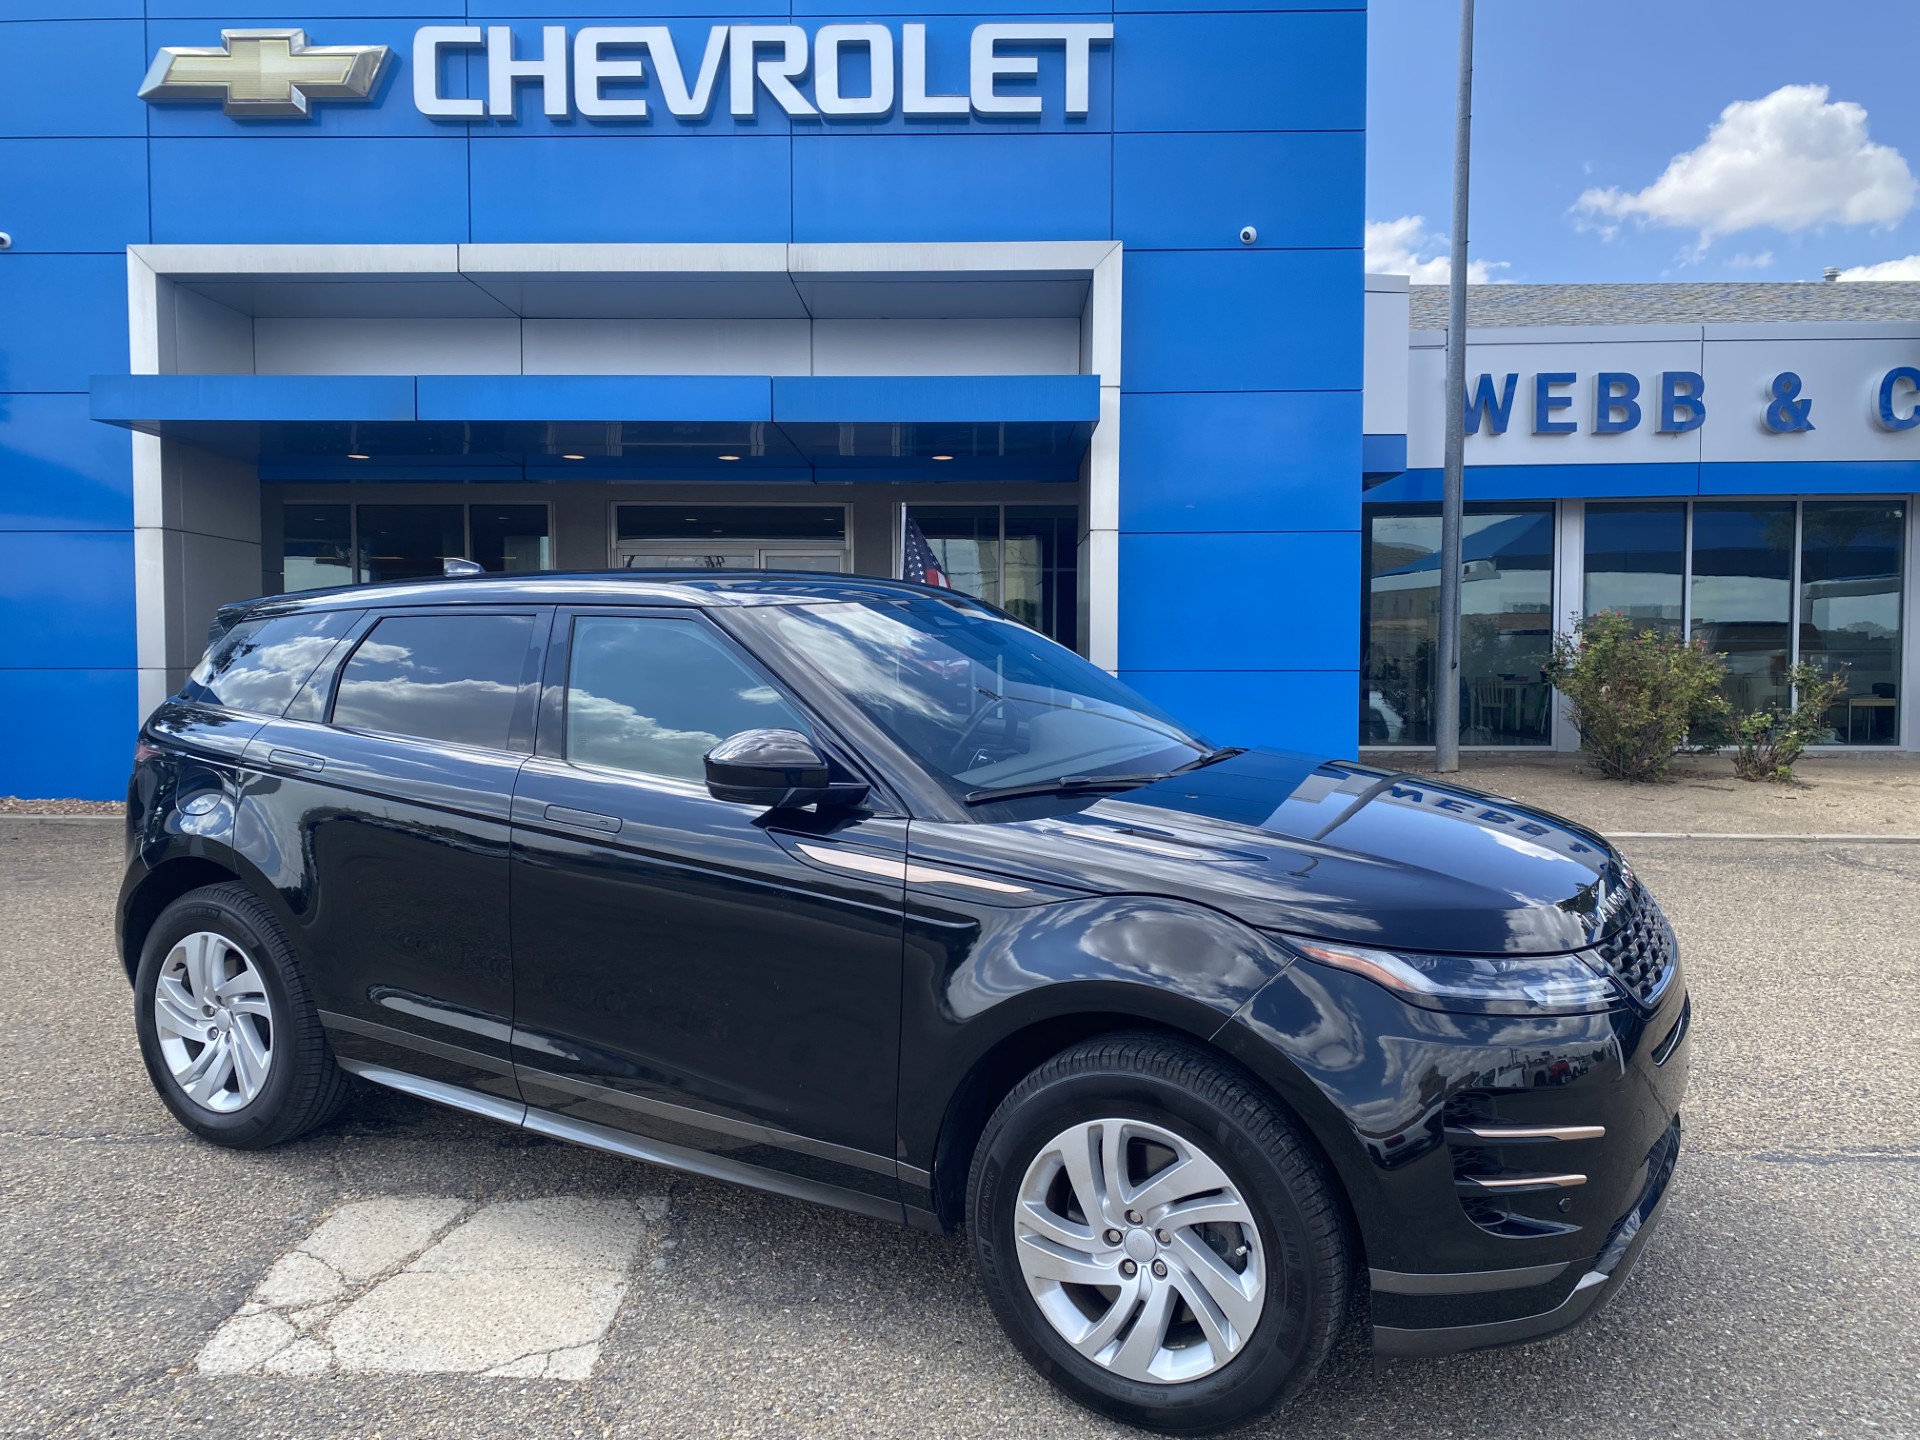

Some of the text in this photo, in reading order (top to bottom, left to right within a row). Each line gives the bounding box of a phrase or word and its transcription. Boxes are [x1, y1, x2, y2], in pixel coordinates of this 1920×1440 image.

[412, 23, 1115, 121] CHEVROLET
[1464, 371, 1706, 435] WEBB
[1761, 371, 1816, 433] &
